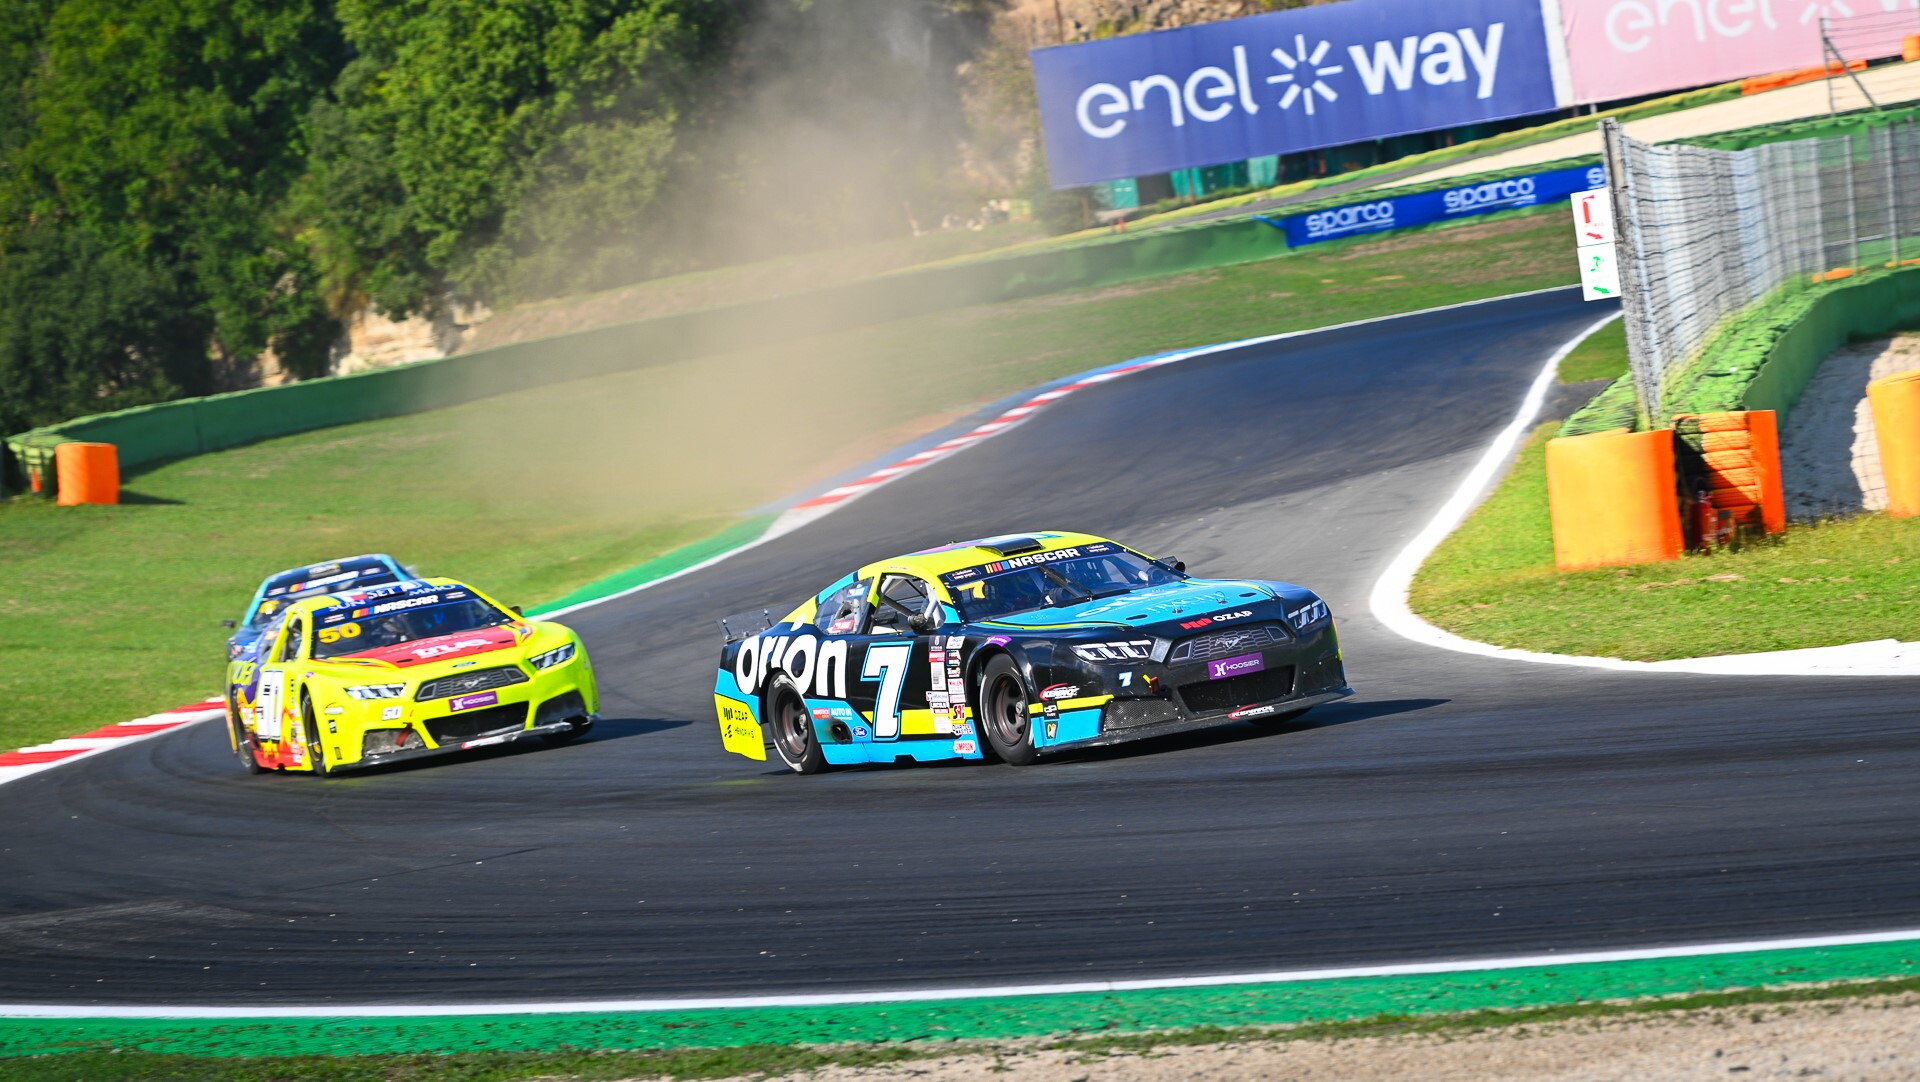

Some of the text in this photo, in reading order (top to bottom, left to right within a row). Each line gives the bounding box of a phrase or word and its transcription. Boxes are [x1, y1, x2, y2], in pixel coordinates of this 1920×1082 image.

[1076, 22, 1504, 138] enel way
[1443, 177, 1535, 211] sparco
[1306, 201, 1395, 235] sparco
[1009, 548, 1081, 569] NASCAR
[957, 580, 986, 599] 7
[373, 595, 439, 614] NASCAR
[1213, 610, 1253, 622] OZAP
[318, 622, 362, 643] 50
[736, 613, 848, 698] orion
[1226, 659, 1260, 671] HOOSIER
[1119, 672, 1132, 687] 7
[861, 641, 914, 741] 7
